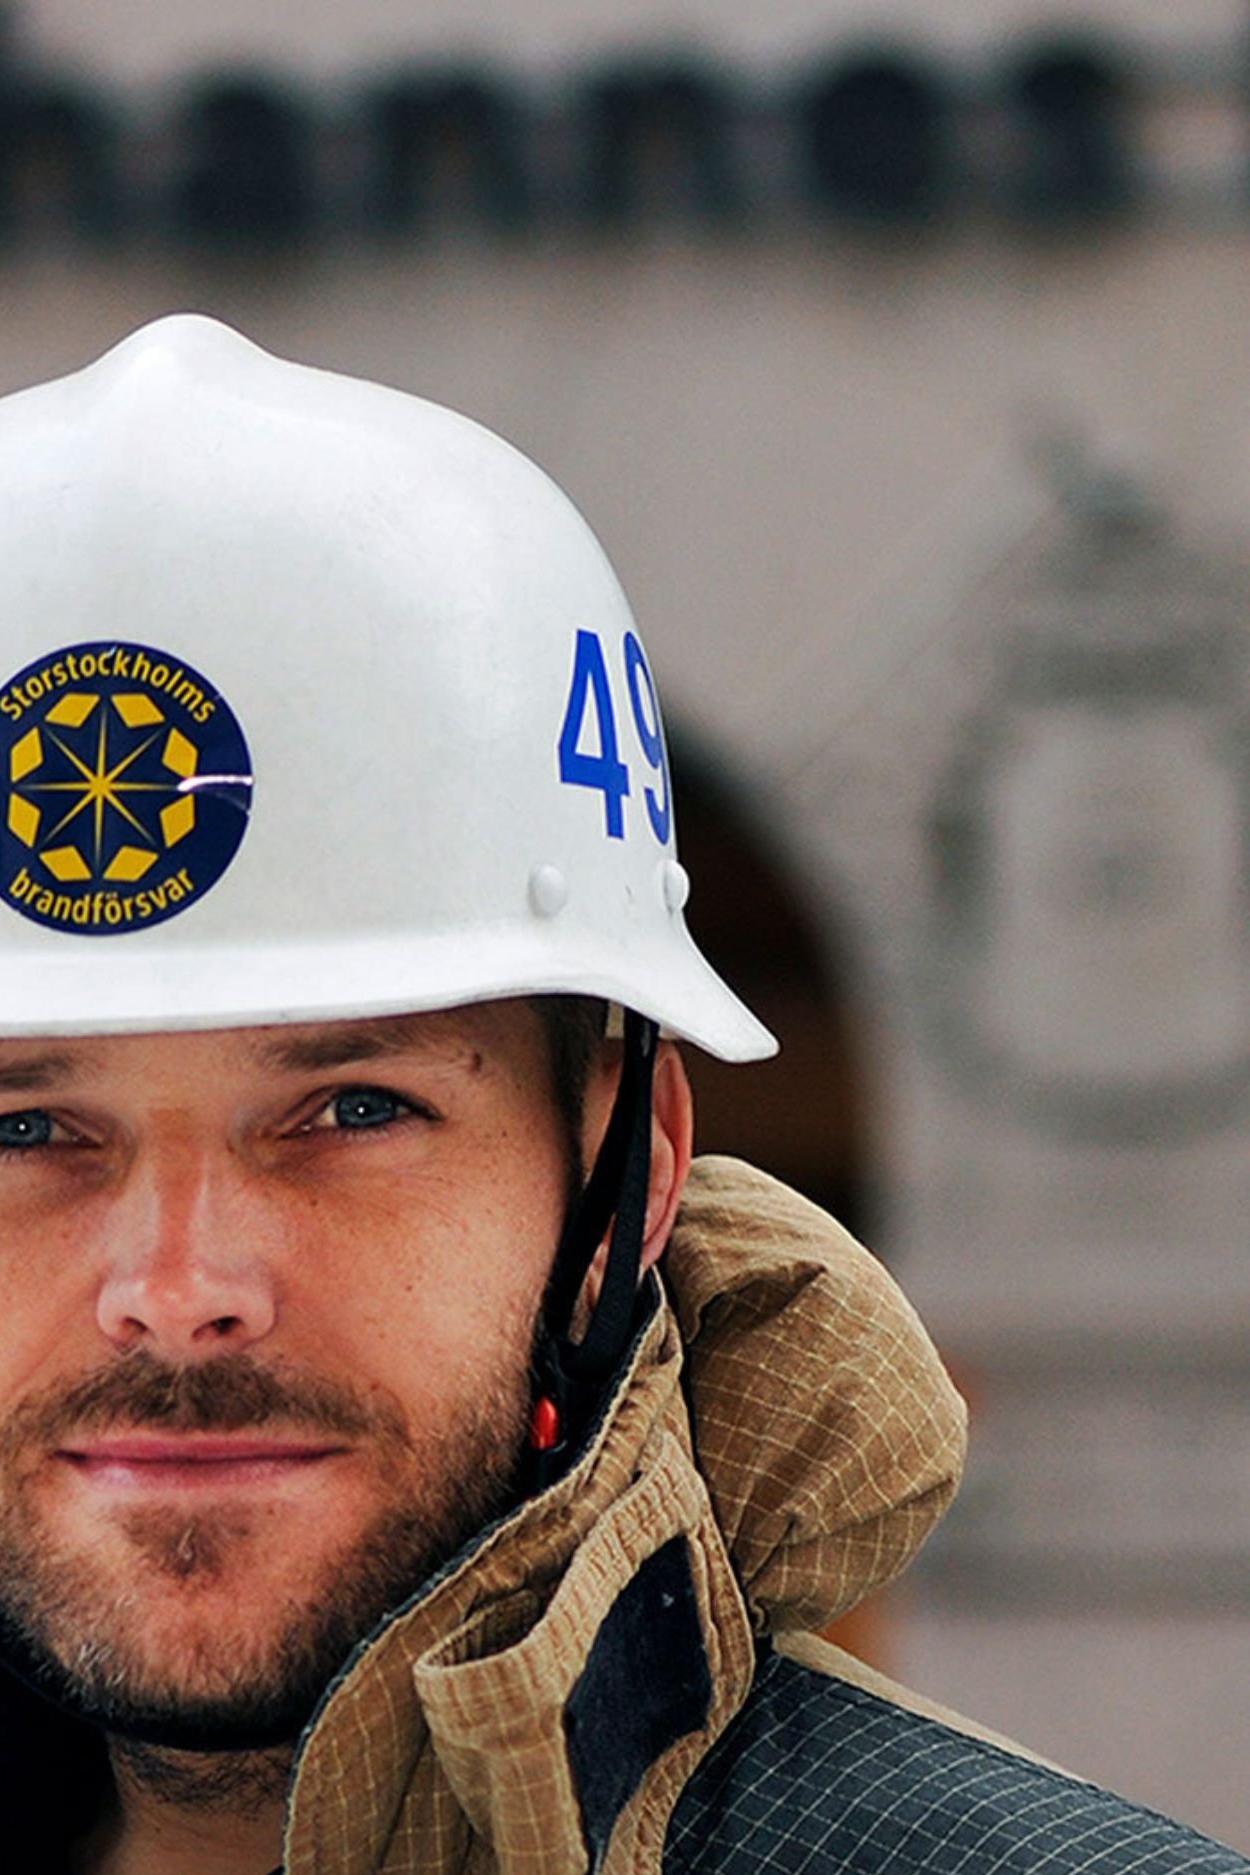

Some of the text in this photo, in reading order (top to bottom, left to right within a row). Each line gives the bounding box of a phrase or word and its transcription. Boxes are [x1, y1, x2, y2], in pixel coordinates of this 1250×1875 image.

[0, 648, 216, 723] Storstockholms
[557, 628, 670, 846] 49
[9, 867, 195, 925] brandförsvar
